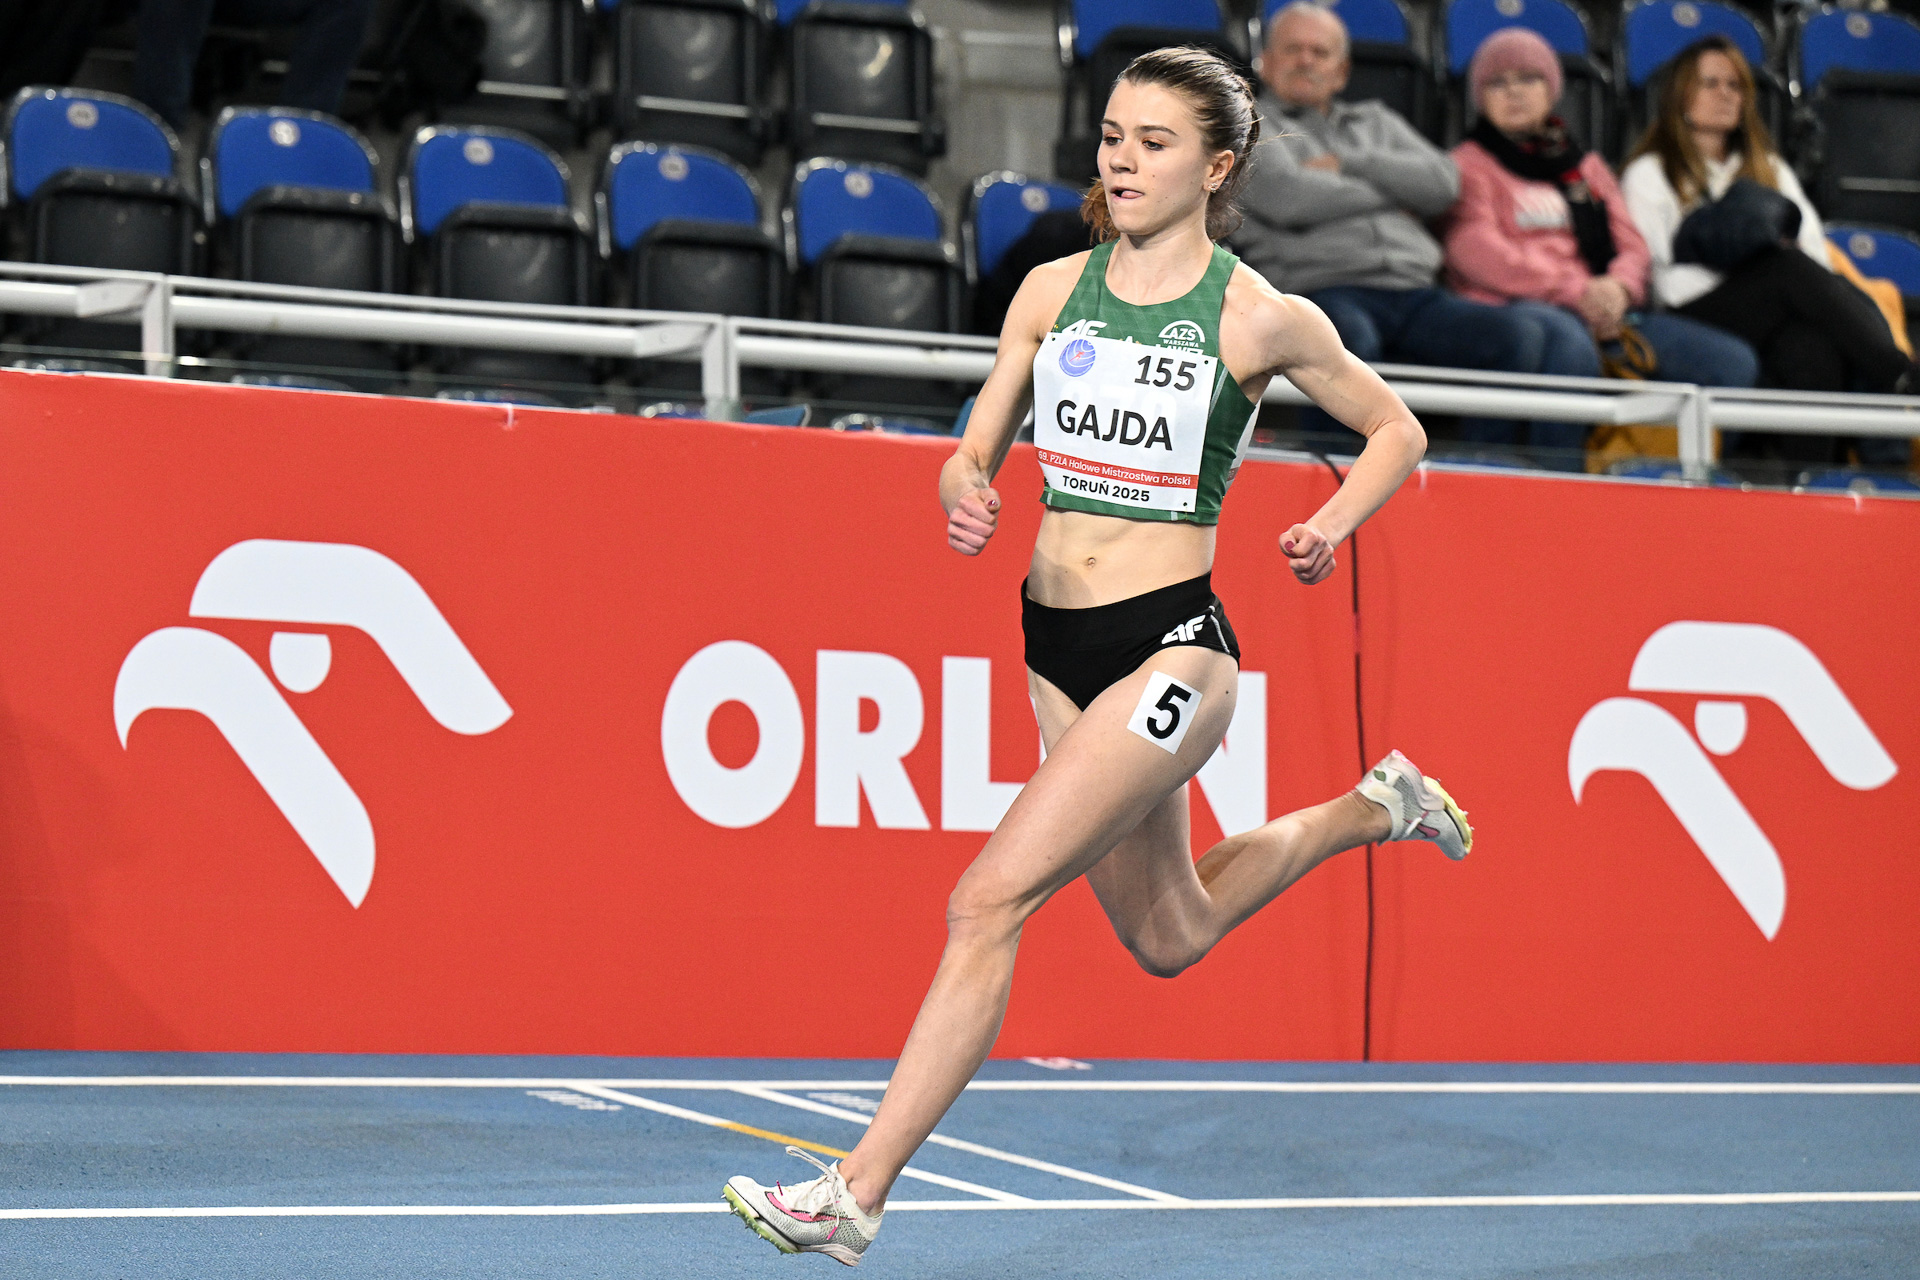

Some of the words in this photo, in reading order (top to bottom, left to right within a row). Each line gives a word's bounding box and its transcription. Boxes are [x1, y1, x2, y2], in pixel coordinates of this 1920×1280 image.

[1163, 338, 1199, 348] WARSZAWA
[1169, 327, 1197, 341] AZS
[1134, 355, 1197, 391] 155
[1056, 400, 1173, 451] GAJDA
[1038, 450, 1049, 462] 69.
[1050, 454, 1067, 467] PZLA
[1068, 459, 1100, 473] Halowe
[1102, 465, 1160, 483] Mistrzostwa
[1161, 475, 1191, 486] Polski
[1062, 475, 1109, 496] TORUŃ
[1111, 485, 1150, 502] 2025
[1146, 682, 1192, 740] 5
[661, 639, 1267, 840] ORLN
